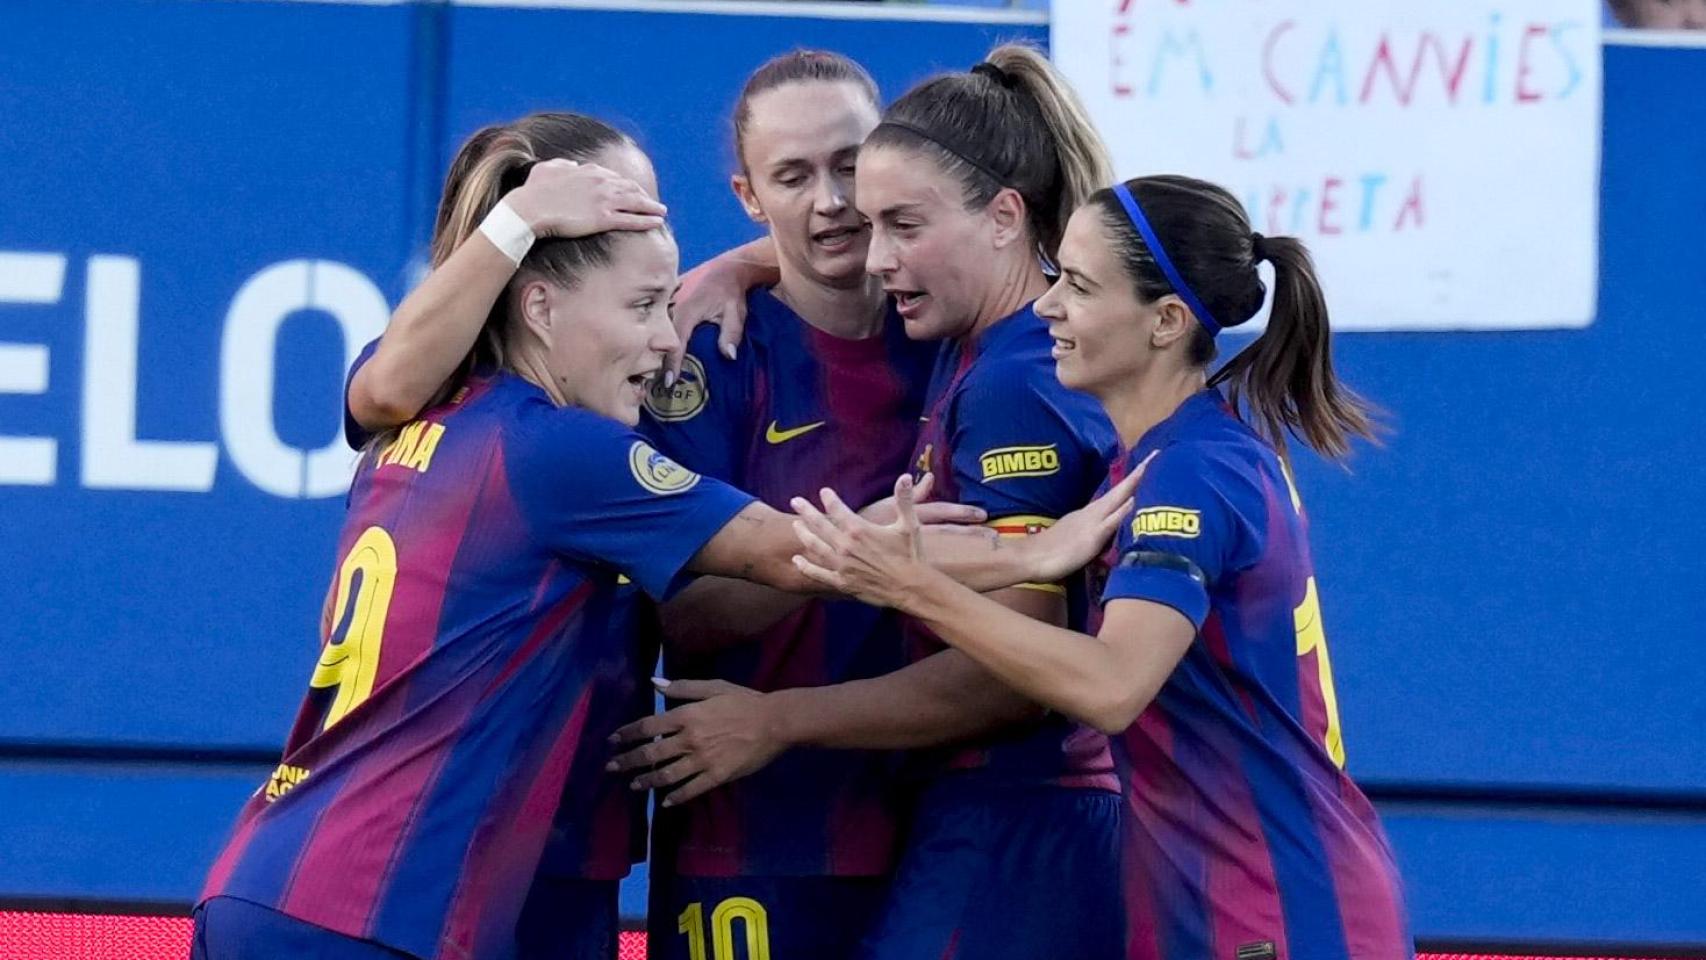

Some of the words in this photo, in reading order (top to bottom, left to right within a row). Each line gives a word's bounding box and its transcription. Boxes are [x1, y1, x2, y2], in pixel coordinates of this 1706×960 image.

[1110, 24, 1214, 98] EM
[1233, 114, 1285, 160] LA
[0, 251, 392, 500] ELO
[981, 449, 1058, 477] BIMBO
[309, 525, 398, 732] 9
[678, 896, 770, 960] 10
